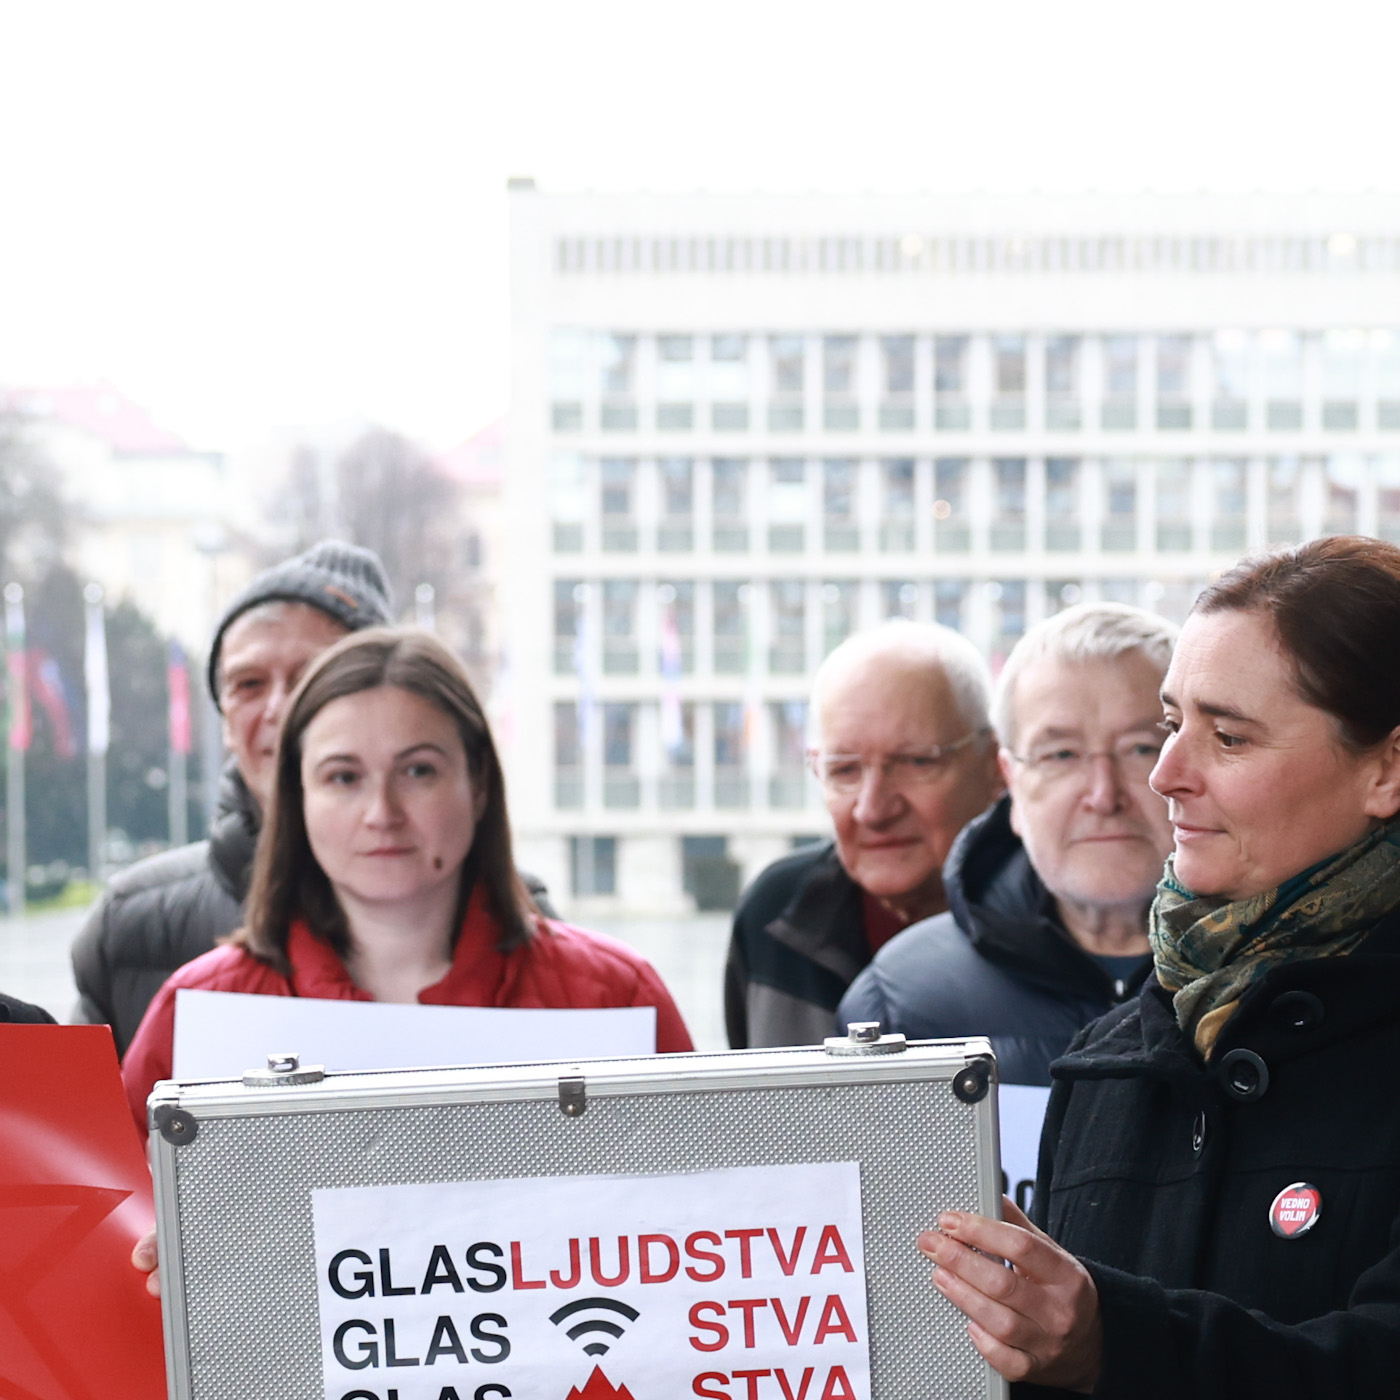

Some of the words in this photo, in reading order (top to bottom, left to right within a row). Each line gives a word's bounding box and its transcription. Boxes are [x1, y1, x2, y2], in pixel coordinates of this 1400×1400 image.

[1280, 1197, 1311, 1209] VEDNO
[332, 1313, 512, 1370] GLAS
[688, 1294, 858, 1352] STVA
